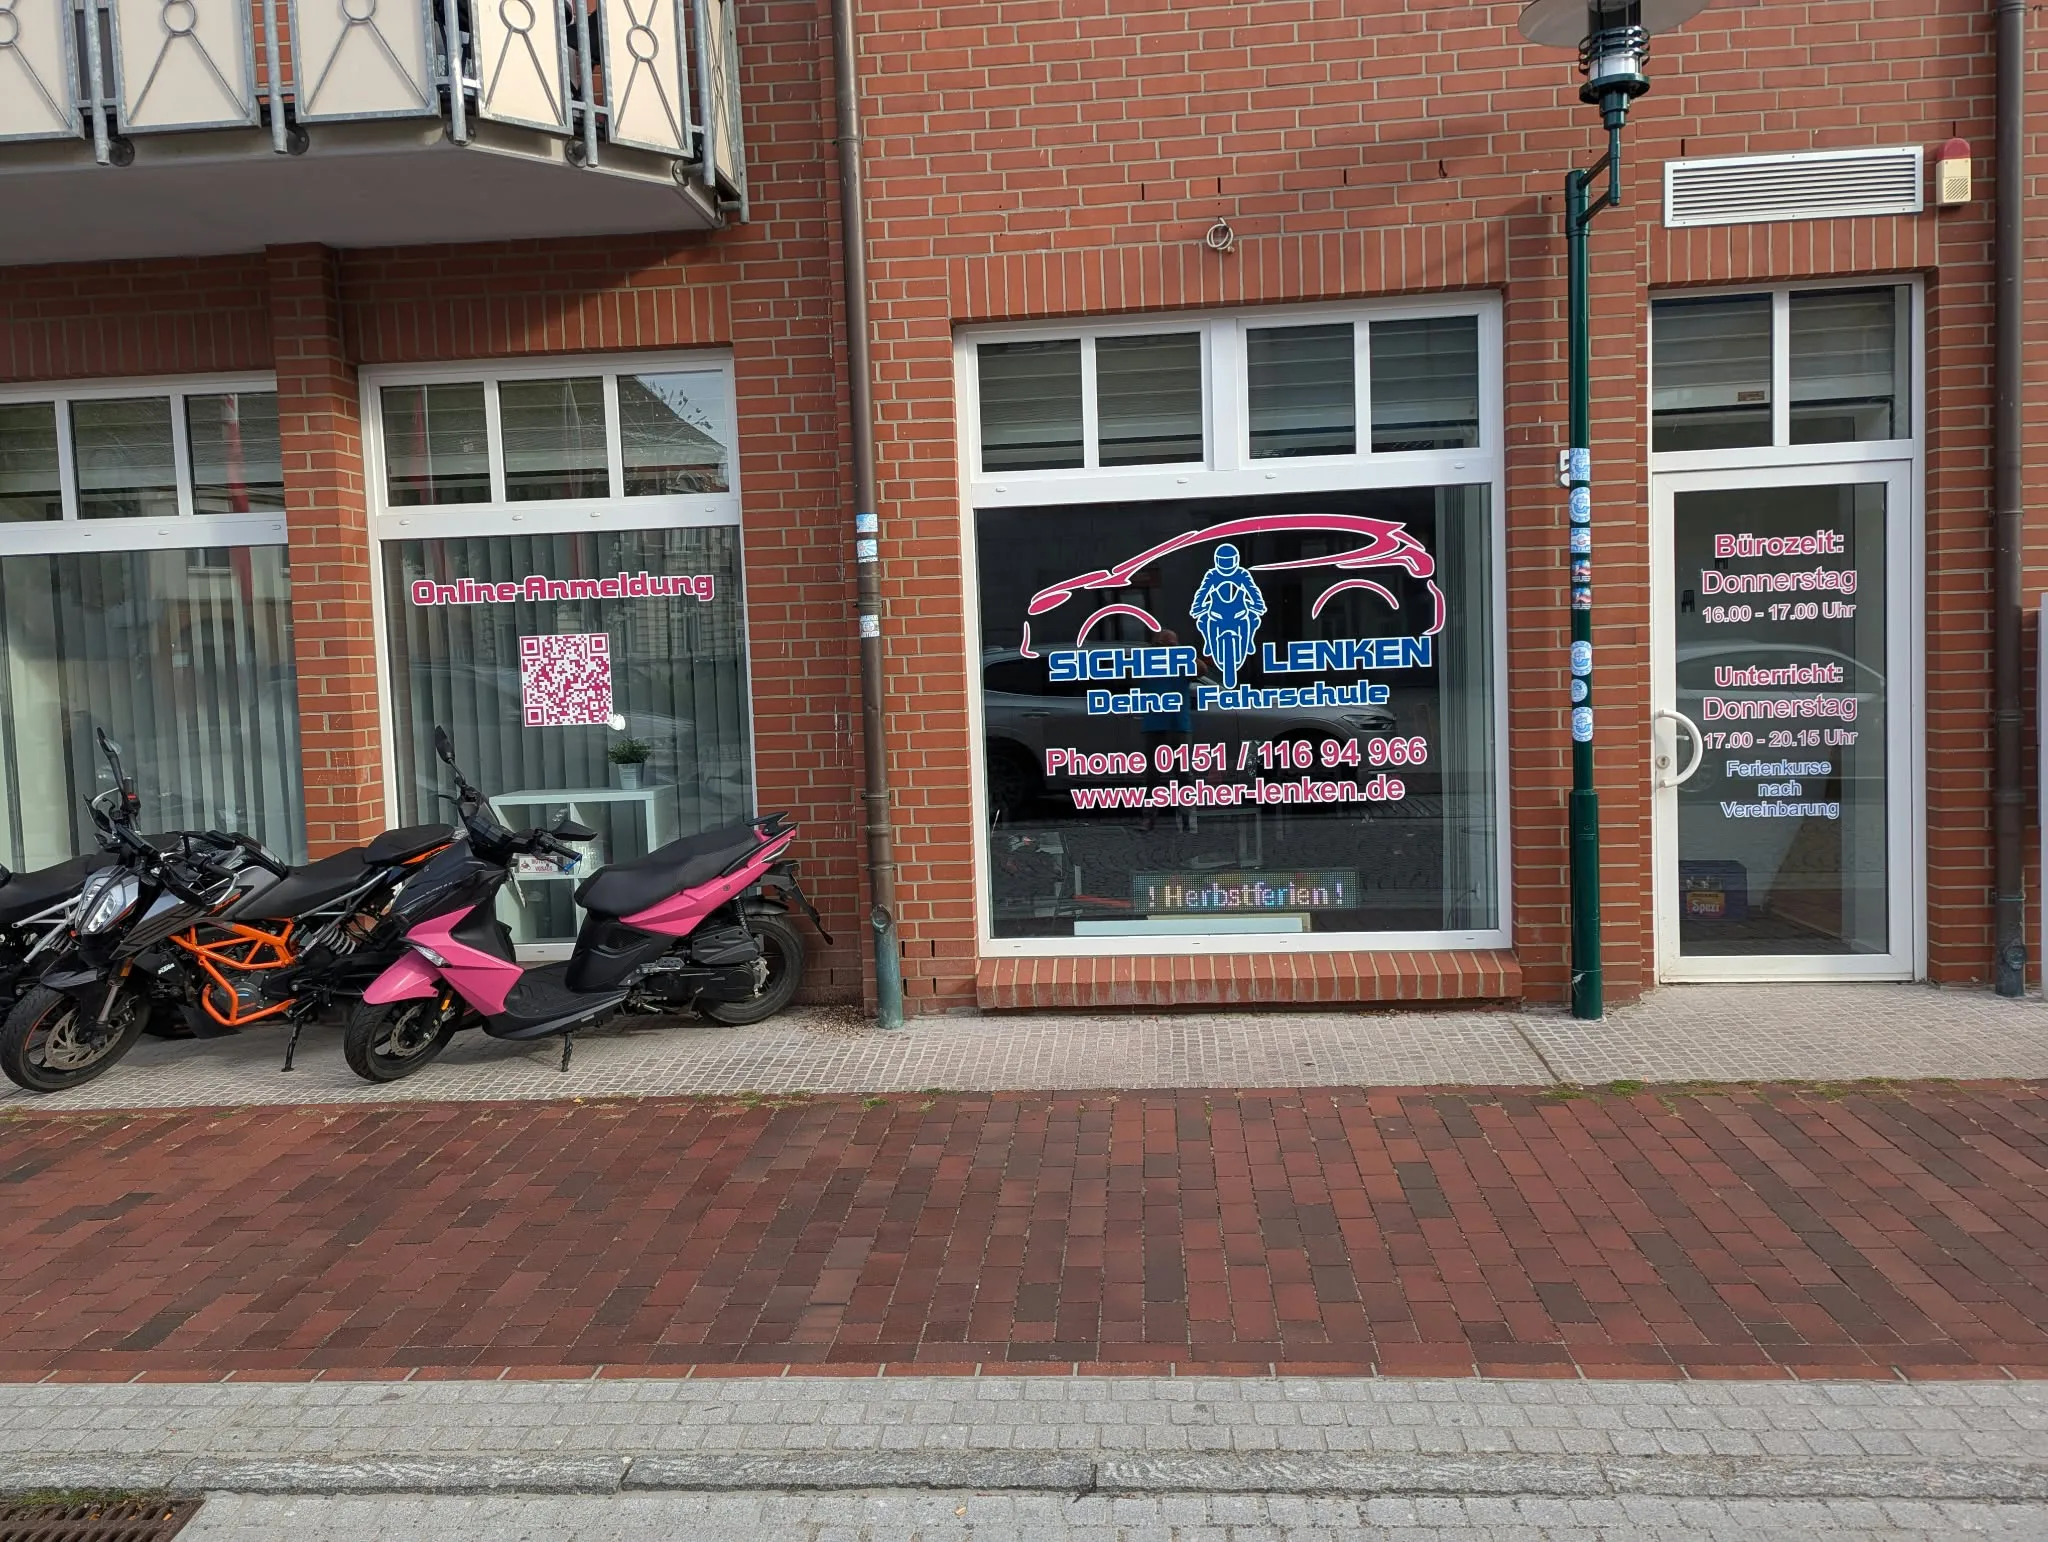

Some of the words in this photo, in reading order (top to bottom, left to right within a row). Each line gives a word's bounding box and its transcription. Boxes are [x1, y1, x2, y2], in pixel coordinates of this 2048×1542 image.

[1715, 529, 1845, 558] Bürozeit:
[411, 571, 715, 606] Online-Anmeldung
[1702, 566, 1857, 594] Donnerstag
[1702, 605, 1752, 623] 16.00
[1768, 603, 1818, 620] 17.00
[1822, 601, 1856, 618] Uhr
[1049, 646, 1198, 681] SICHER
[1262, 636, 1432, 673] LENKEN
[1715, 662, 1844, 687] Unterricht:
[1086, 688, 1183, 715] Deine
[1197, 680, 1389, 711] Fahrschule
[1703, 693, 1858, 721] Donnerstag
[1703, 732, 1753, 749] 17.00
[1756, 736, 1766, 744] -
[1768, 730, 1820, 748] 20.15
[1824, 728, 1858, 745] Uhr
[1046, 748, 1147, 776] Phone
[1154, 743, 1227, 772] 0151
[1236, 741, 1250, 771] /
[1257, 740, 1313, 769] 116
[1320, 738, 1361, 767] 94
[1368, 736, 1427, 766] 966
[1726, 759, 1831, 777] Ferienkurse
[1070, 774, 1405, 809] www.sicher-lenken.de
[1758, 780, 1802, 797] nach
[1720, 801, 1839, 819] Vereinbarung
[1165, 881, 1329, 907] Herbstferien
